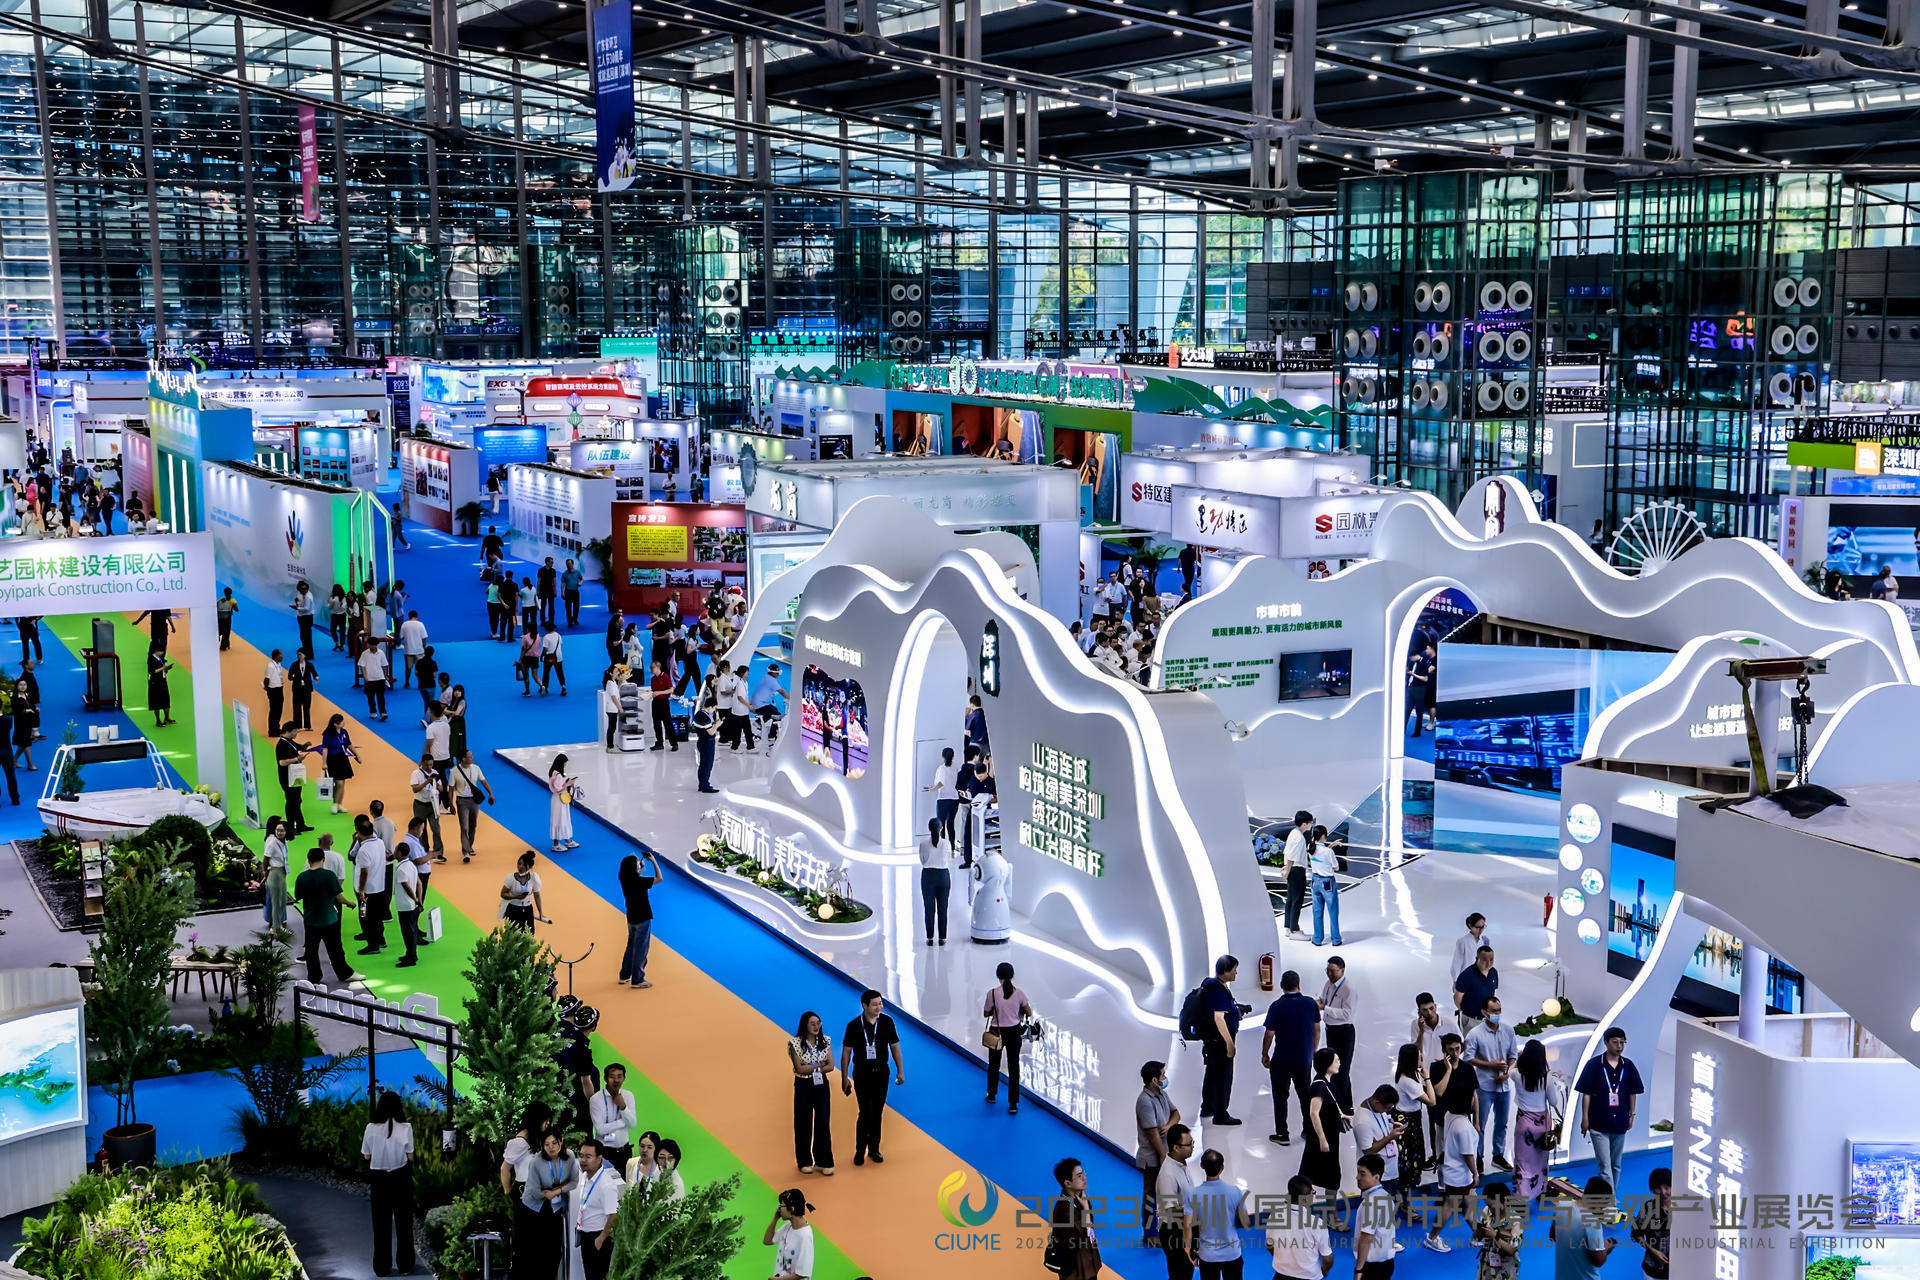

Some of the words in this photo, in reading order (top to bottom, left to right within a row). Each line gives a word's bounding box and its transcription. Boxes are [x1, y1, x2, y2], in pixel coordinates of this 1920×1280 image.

[487, 380, 508, 388] EXC
[587, 449, 631, 461] 队伍建设
[49, 578, 134, 598] Construction
[136, 577, 161, 594] Co.,
[163, 576, 187, 592] Ltd.
[1032, 742, 1088, 786] 山海连城
[1018, 765, 1103, 821] 构筑绿美深圳
[1032, 798, 1089, 843] 绣花功夫
[1687, 1051, 1717, 1200] 首善之区
